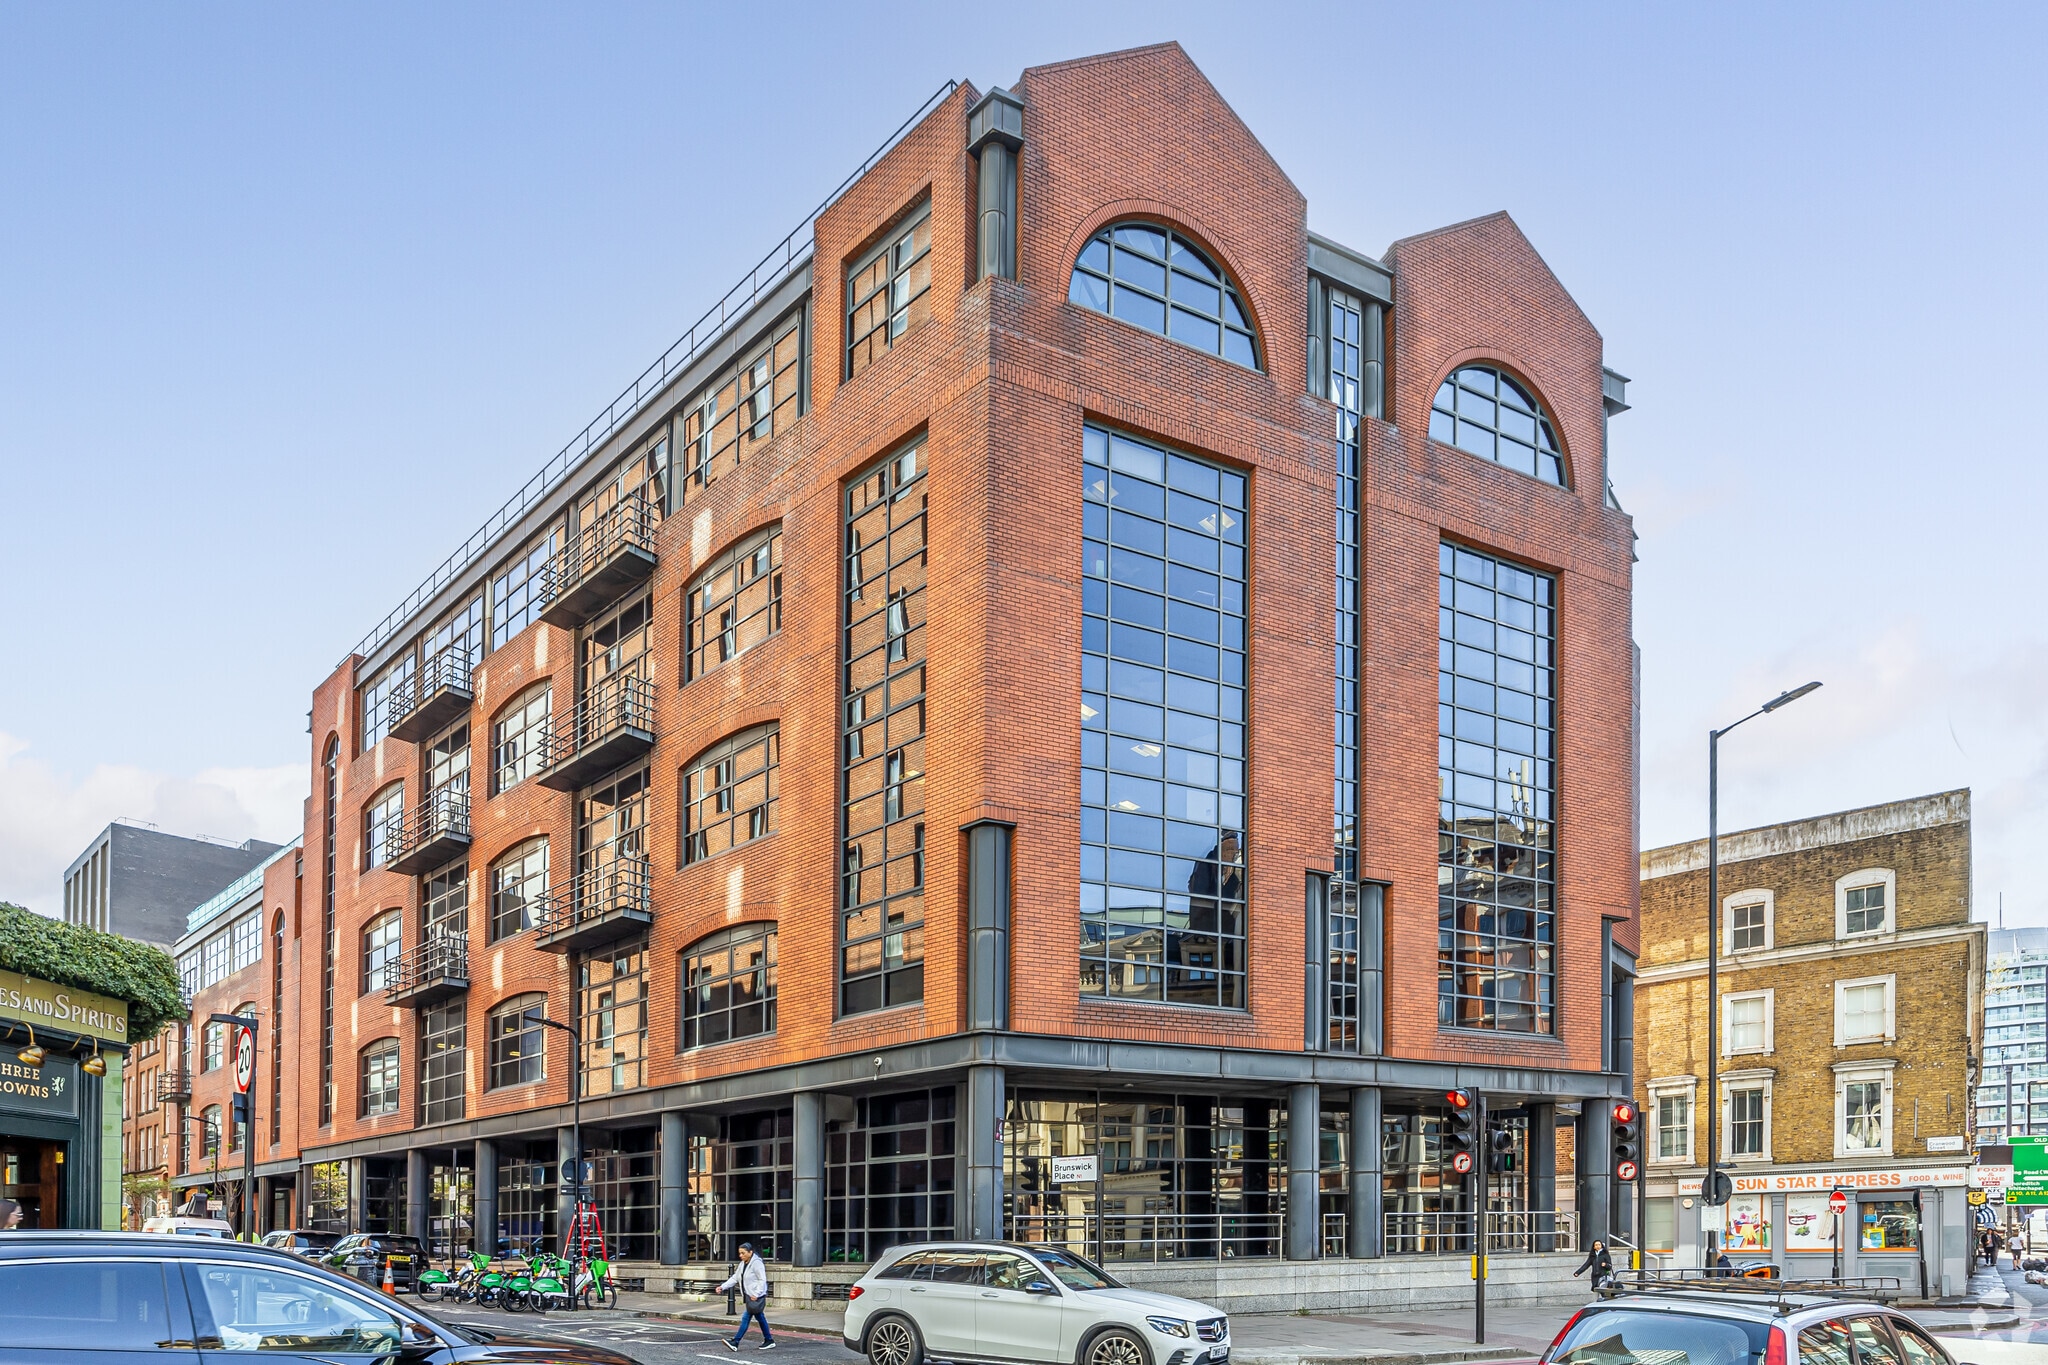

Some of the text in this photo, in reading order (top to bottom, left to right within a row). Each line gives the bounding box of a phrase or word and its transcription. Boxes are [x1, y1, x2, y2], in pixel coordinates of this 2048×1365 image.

[239, 1045, 250, 1073] 20
[0, 1080, 49, 1098] OWNS
[1054, 1163, 1092, 1171] Brunswick
[1737, 1174, 1900, 1190] SUN STAR EXPRESS
